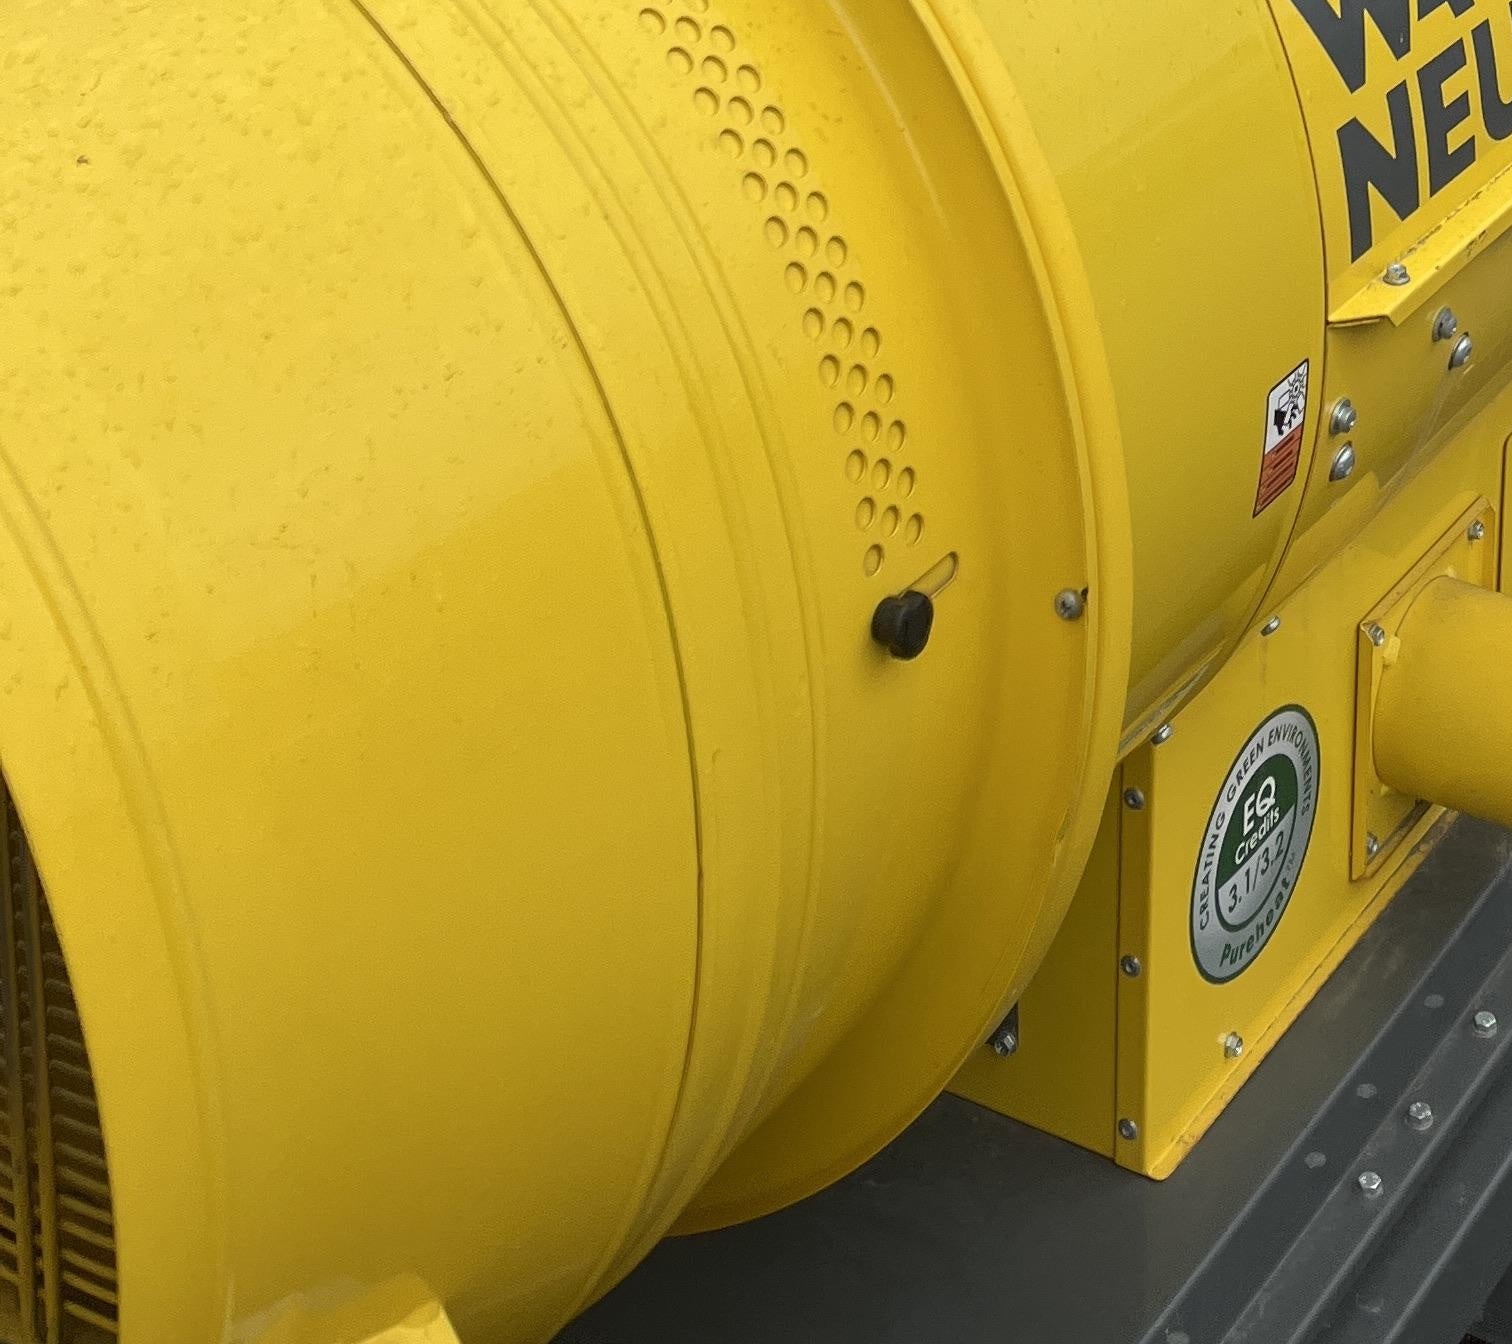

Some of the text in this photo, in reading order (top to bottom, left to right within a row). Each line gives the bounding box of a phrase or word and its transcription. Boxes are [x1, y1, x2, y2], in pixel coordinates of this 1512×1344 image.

[1199, 723, 1314, 930] CREATING GREEN ENVIRONMENTS
[1234, 804, 1281, 865] Credits
[1242, 775, 1276, 837] EQ
[1227, 830, 1285, 913] 3.1/3.2
[1219, 877, 1291, 967] Pureheat
